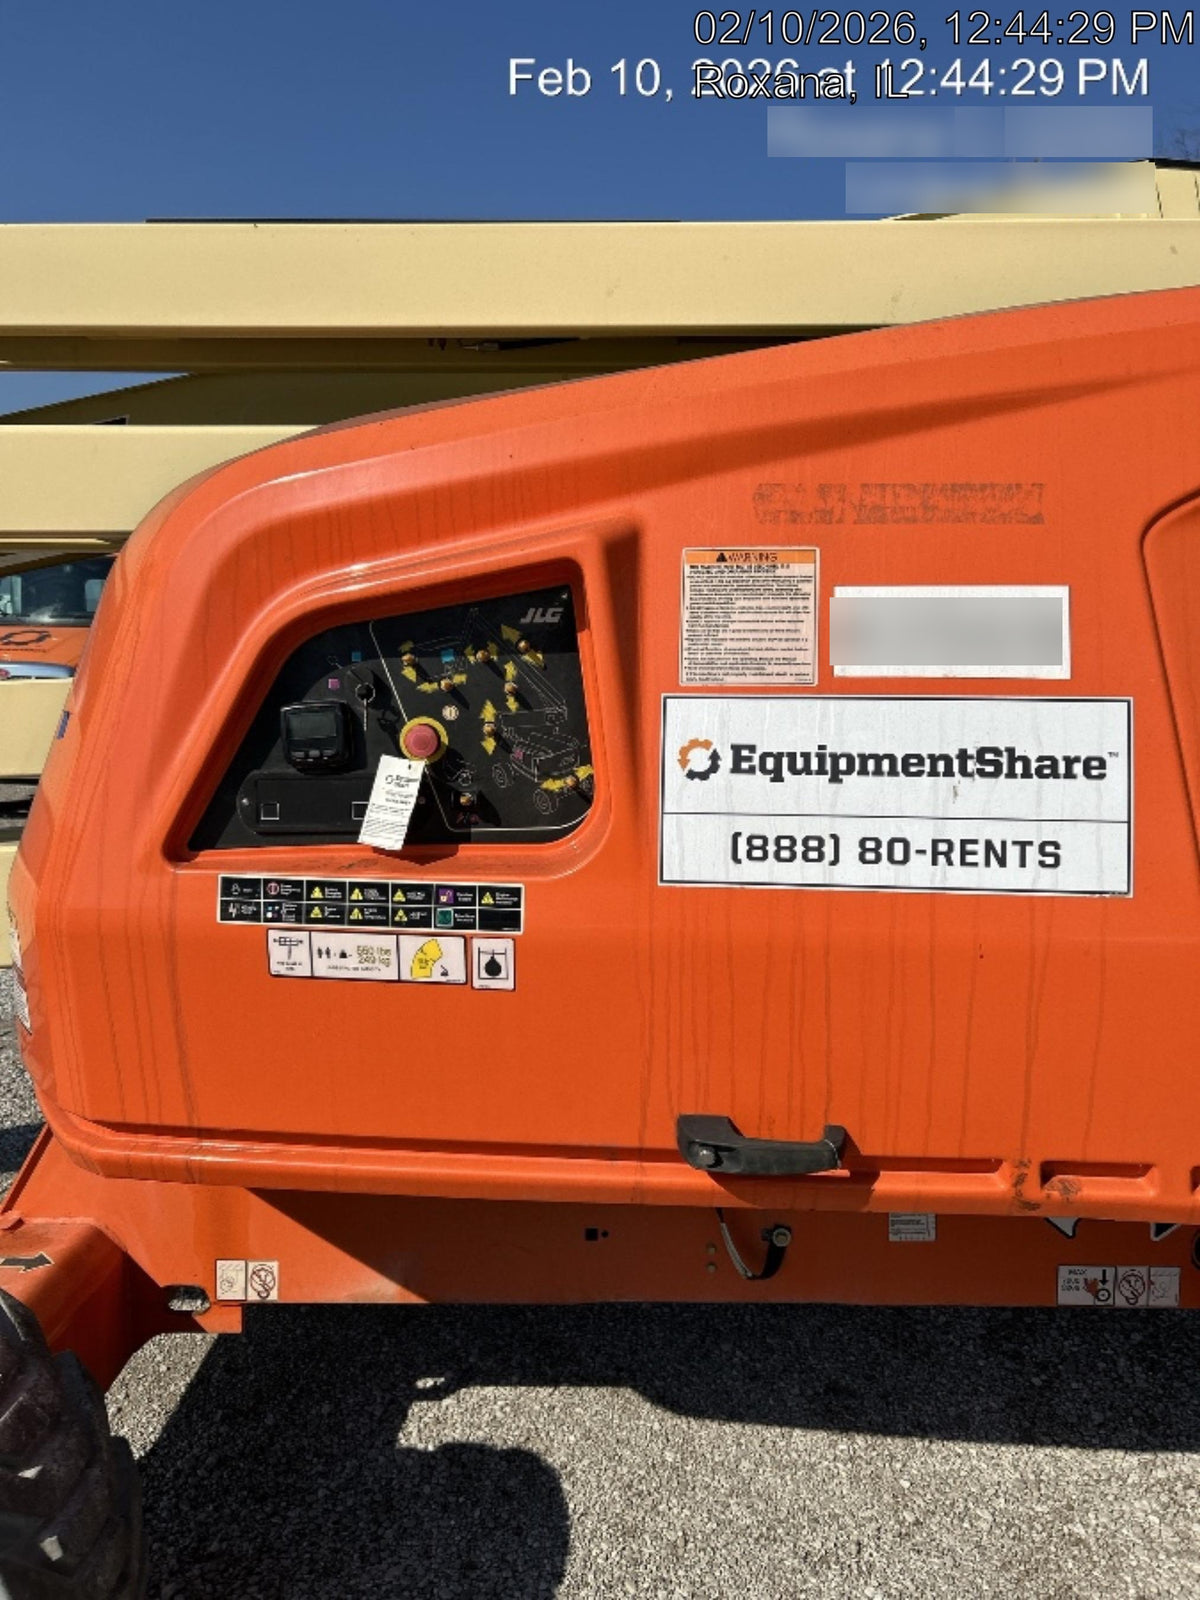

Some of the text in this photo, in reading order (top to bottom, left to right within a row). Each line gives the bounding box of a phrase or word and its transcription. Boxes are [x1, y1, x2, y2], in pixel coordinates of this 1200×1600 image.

[728, 552, 777, 563] WARNING
[520, 607, 564, 624] JLG
[730, 831, 1062, 868] (888) 80-RENTS
